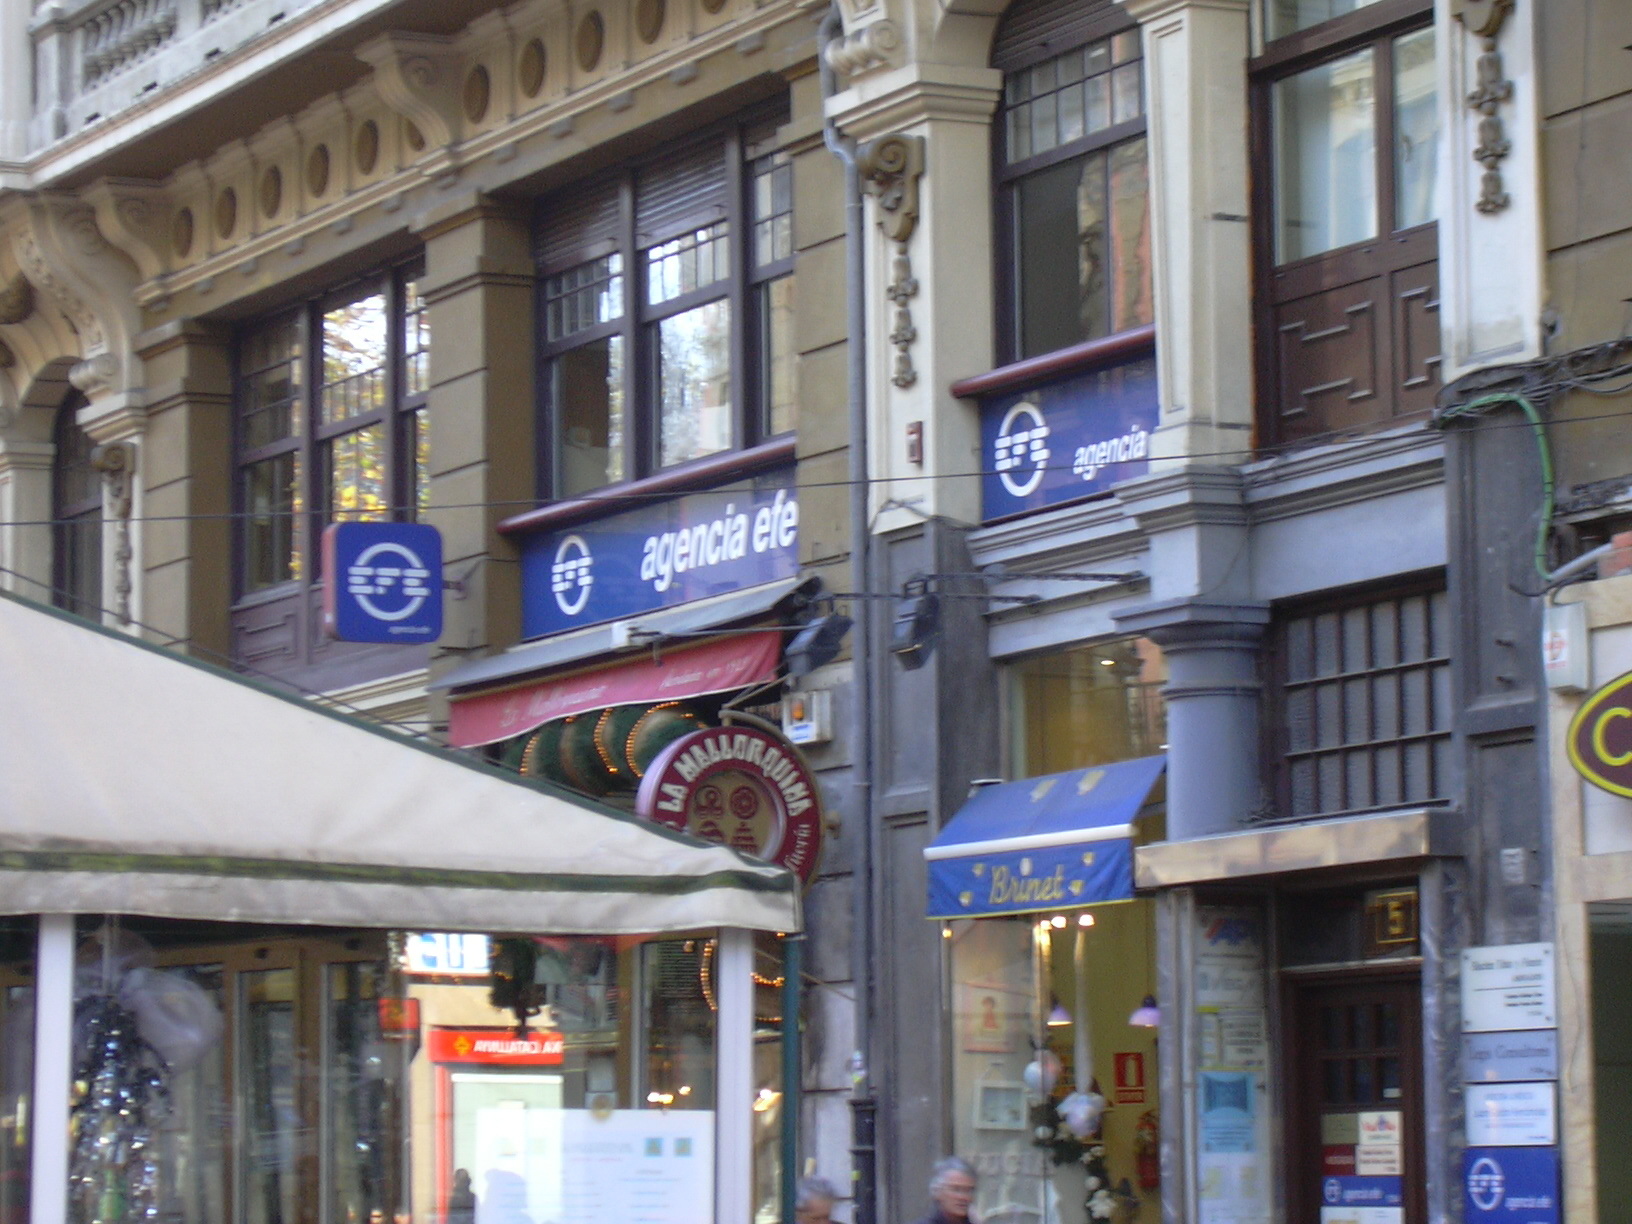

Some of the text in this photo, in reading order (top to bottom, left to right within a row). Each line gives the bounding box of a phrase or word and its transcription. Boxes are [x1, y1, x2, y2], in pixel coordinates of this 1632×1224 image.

[1072, 424, 1149, 481] agencia
[640, 488, 799, 593] agencia efe
[656, 734, 814, 817] LA MALLORQUINA
[988, 863, 1065, 905] Brinet
[1387, 900, 1406, 935] 5
